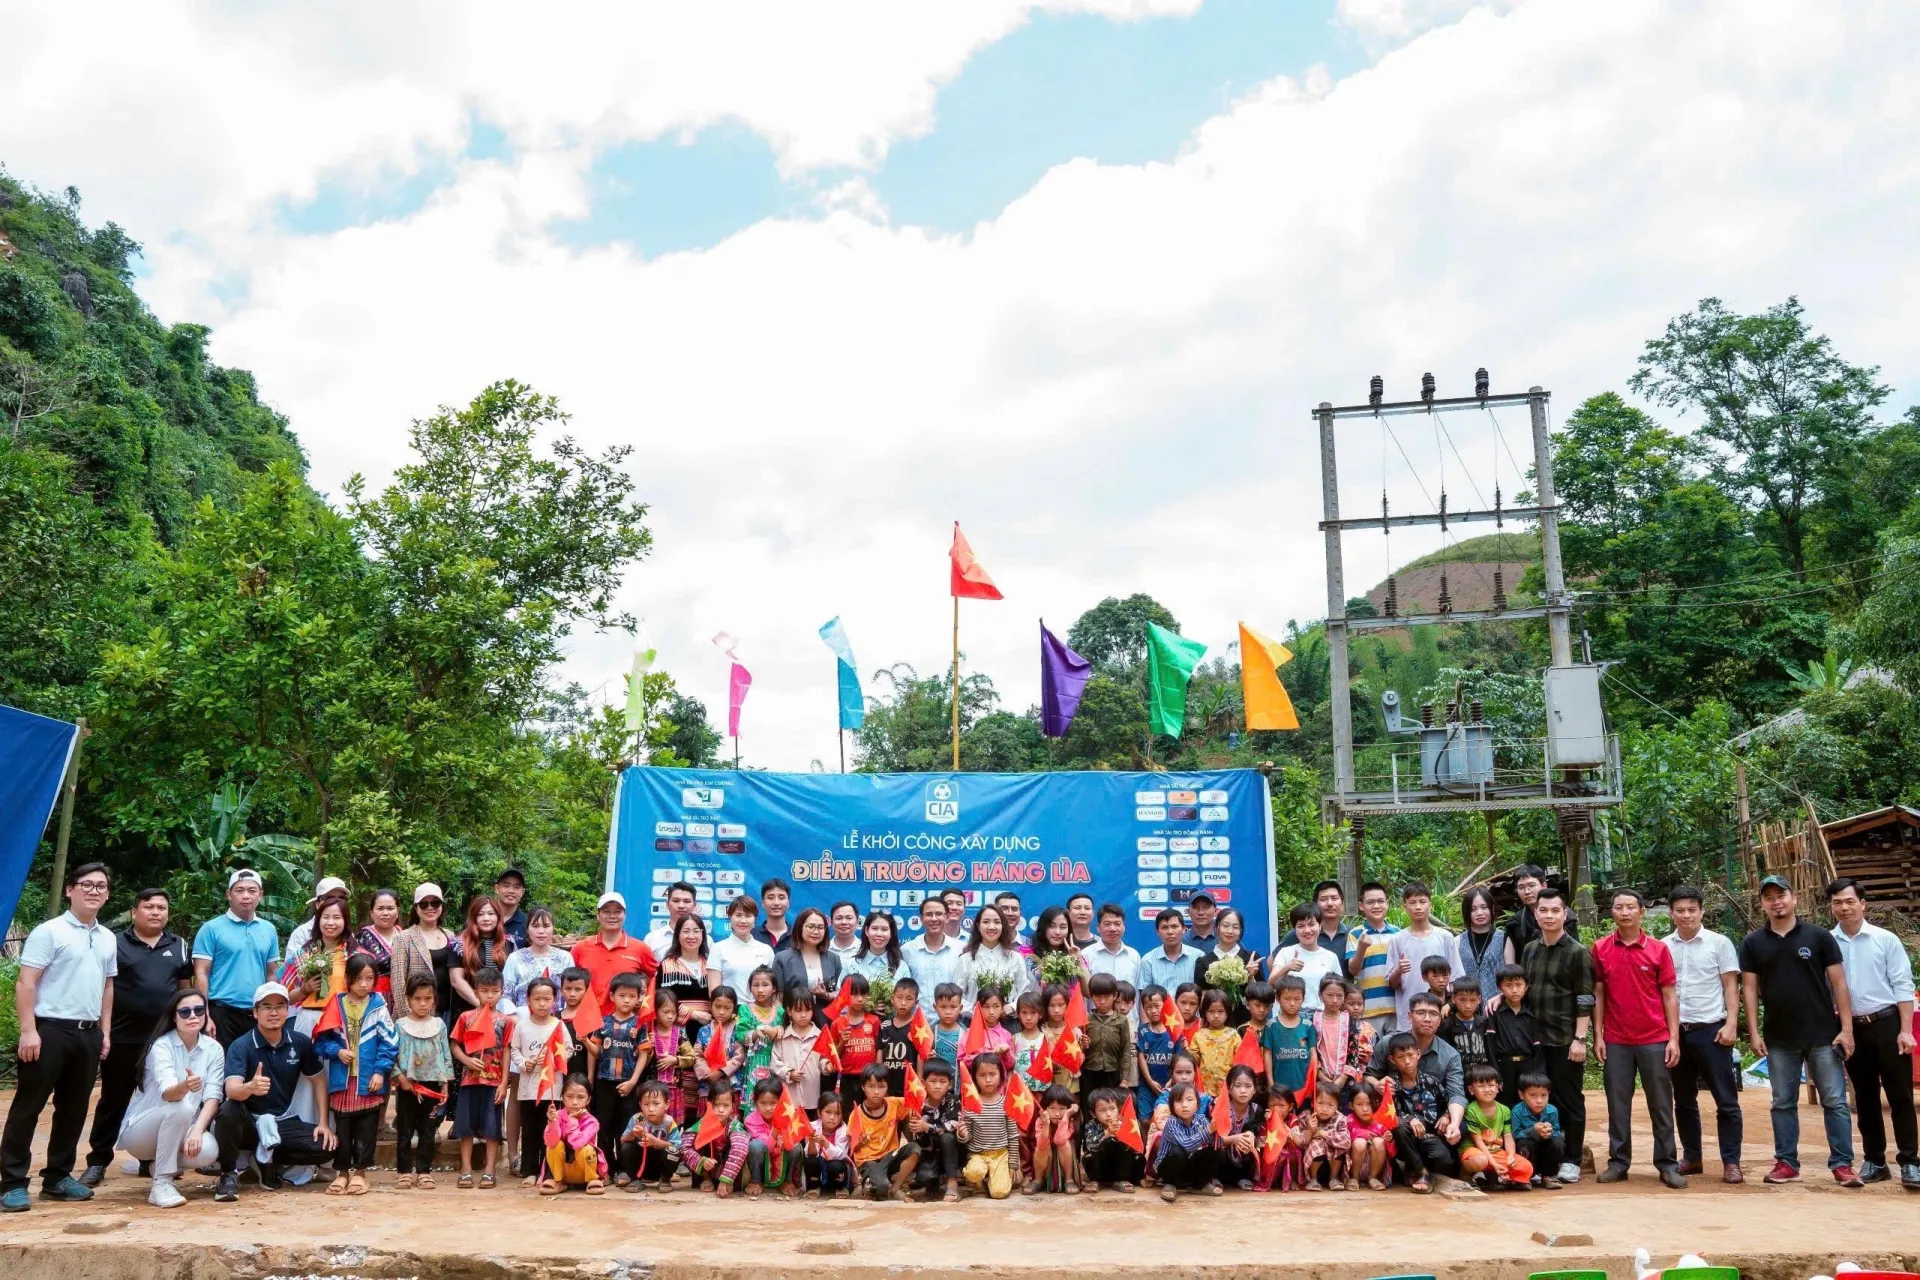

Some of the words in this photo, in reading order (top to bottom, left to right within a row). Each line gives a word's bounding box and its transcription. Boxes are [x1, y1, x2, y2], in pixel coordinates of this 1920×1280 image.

[928, 802, 955, 816] CIA
[843, 829, 859, 849] LỄ
[862, 830, 900, 849] KHỞI
[904, 832, 956, 850] CÔNG
[960, 834, 989, 850] XÂY
[993, 835, 1041, 853] DỰNG
[792, 850, 857, 882] ĐIỂM
[861, 855, 966, 883] TRƯỜNG
[971, 857, 1046, 883] HÁNG
[1051, 857, 1091, 884] LÌA
[845, 1037, 875, 1046] mirates
[885, 1041, 907, 1060] 10
